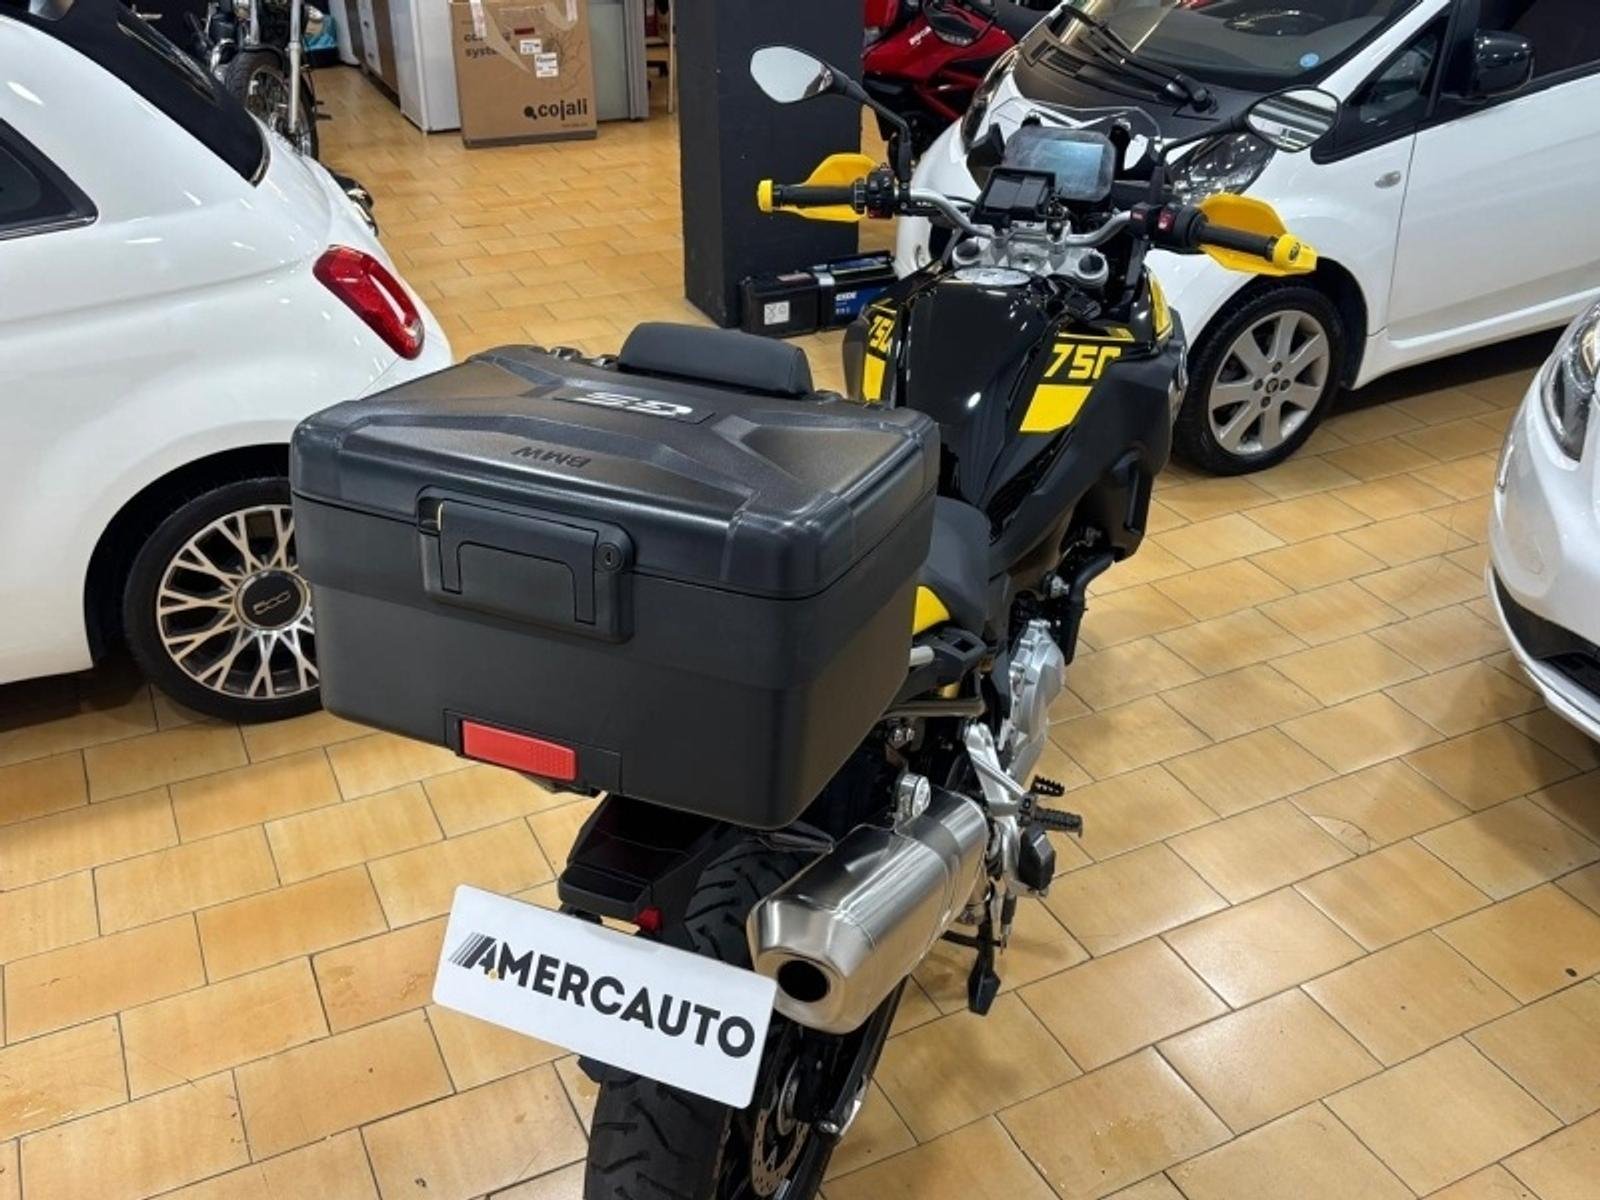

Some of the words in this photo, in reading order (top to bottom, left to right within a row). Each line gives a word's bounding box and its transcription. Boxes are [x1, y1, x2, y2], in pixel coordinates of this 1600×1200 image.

[538, 98, 588, 120] cojali
[511, 446, 591, 468] BMW
[449, 932, 755, 1058] AMERCAUTO
